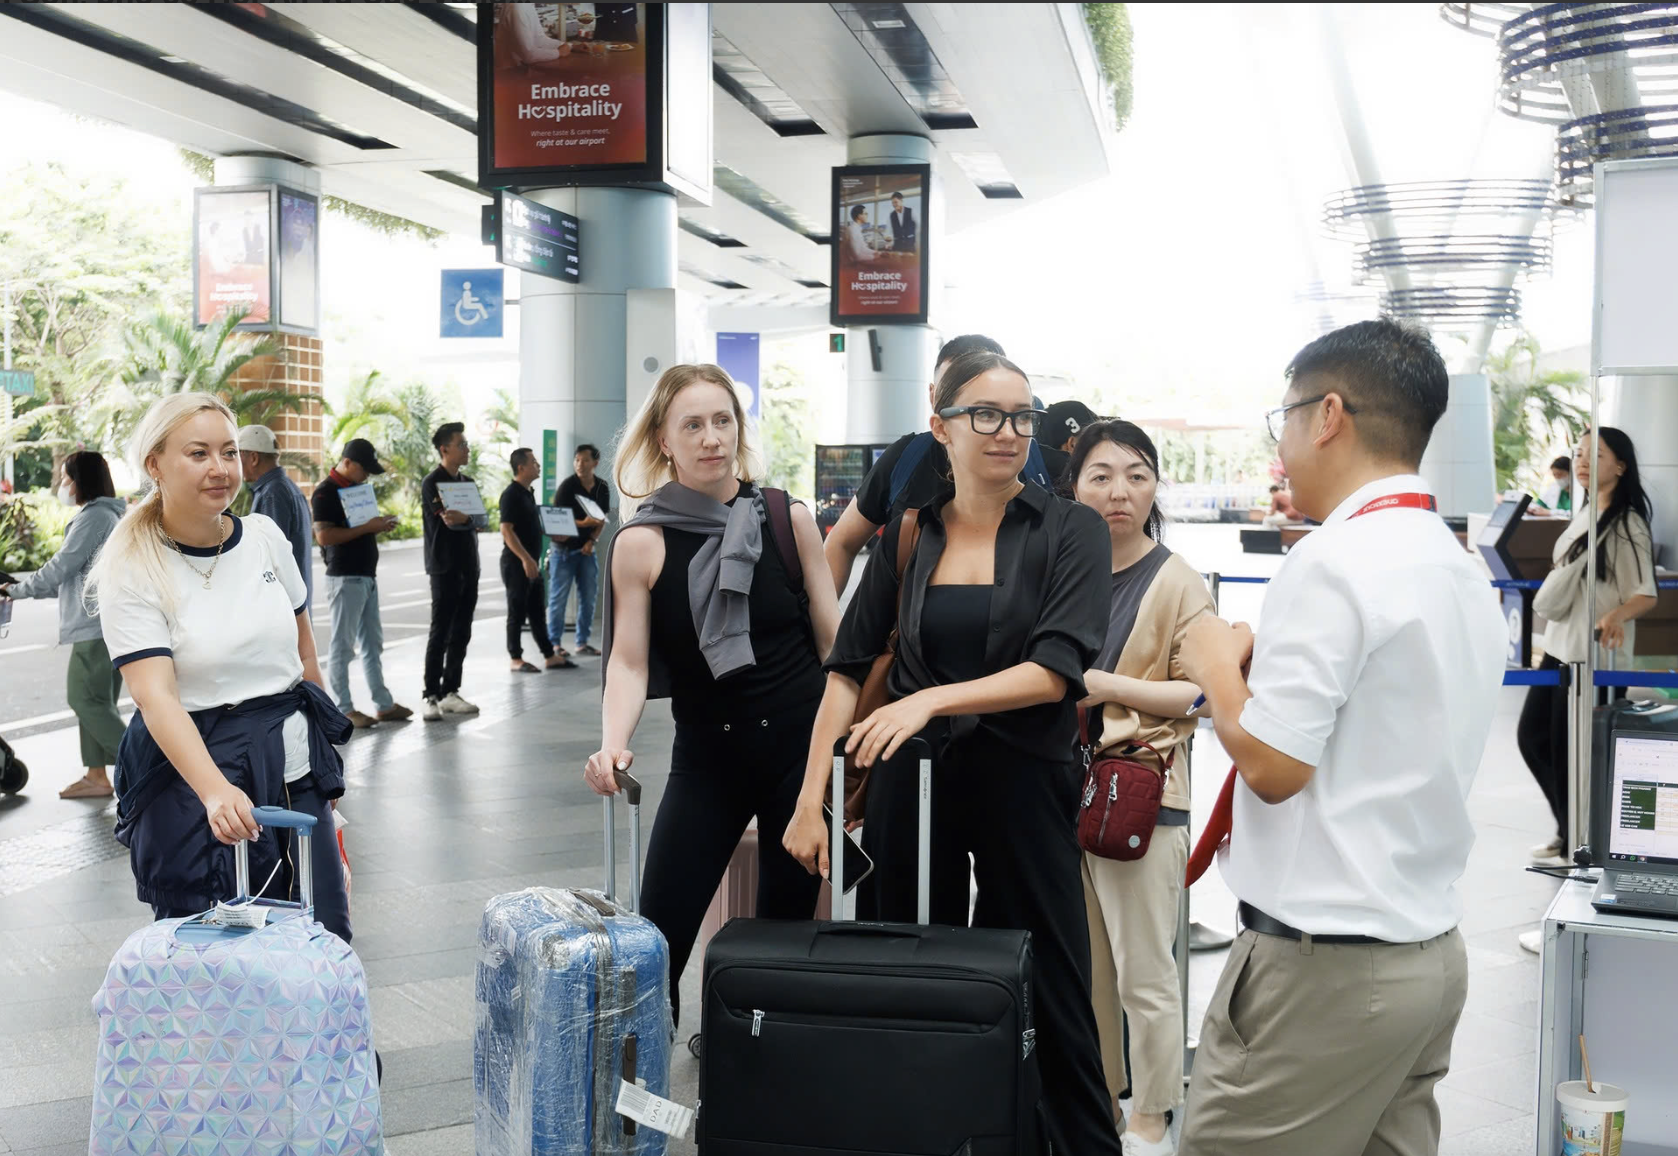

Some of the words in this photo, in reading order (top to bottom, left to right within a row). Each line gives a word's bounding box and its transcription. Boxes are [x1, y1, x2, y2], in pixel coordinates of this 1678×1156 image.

[531, 82, 610, 99] Embrace
[518, 99, 622, 122] Hospitality
[536, 138, 554, 148] right
[555, 138, 564, 146] at
[579, 137, 605, 146] airport
[858, 271, 902, 281] Embrace
[1065, 417, 1081, 433] 3
[650, 1100, 662, 1123] DAD
